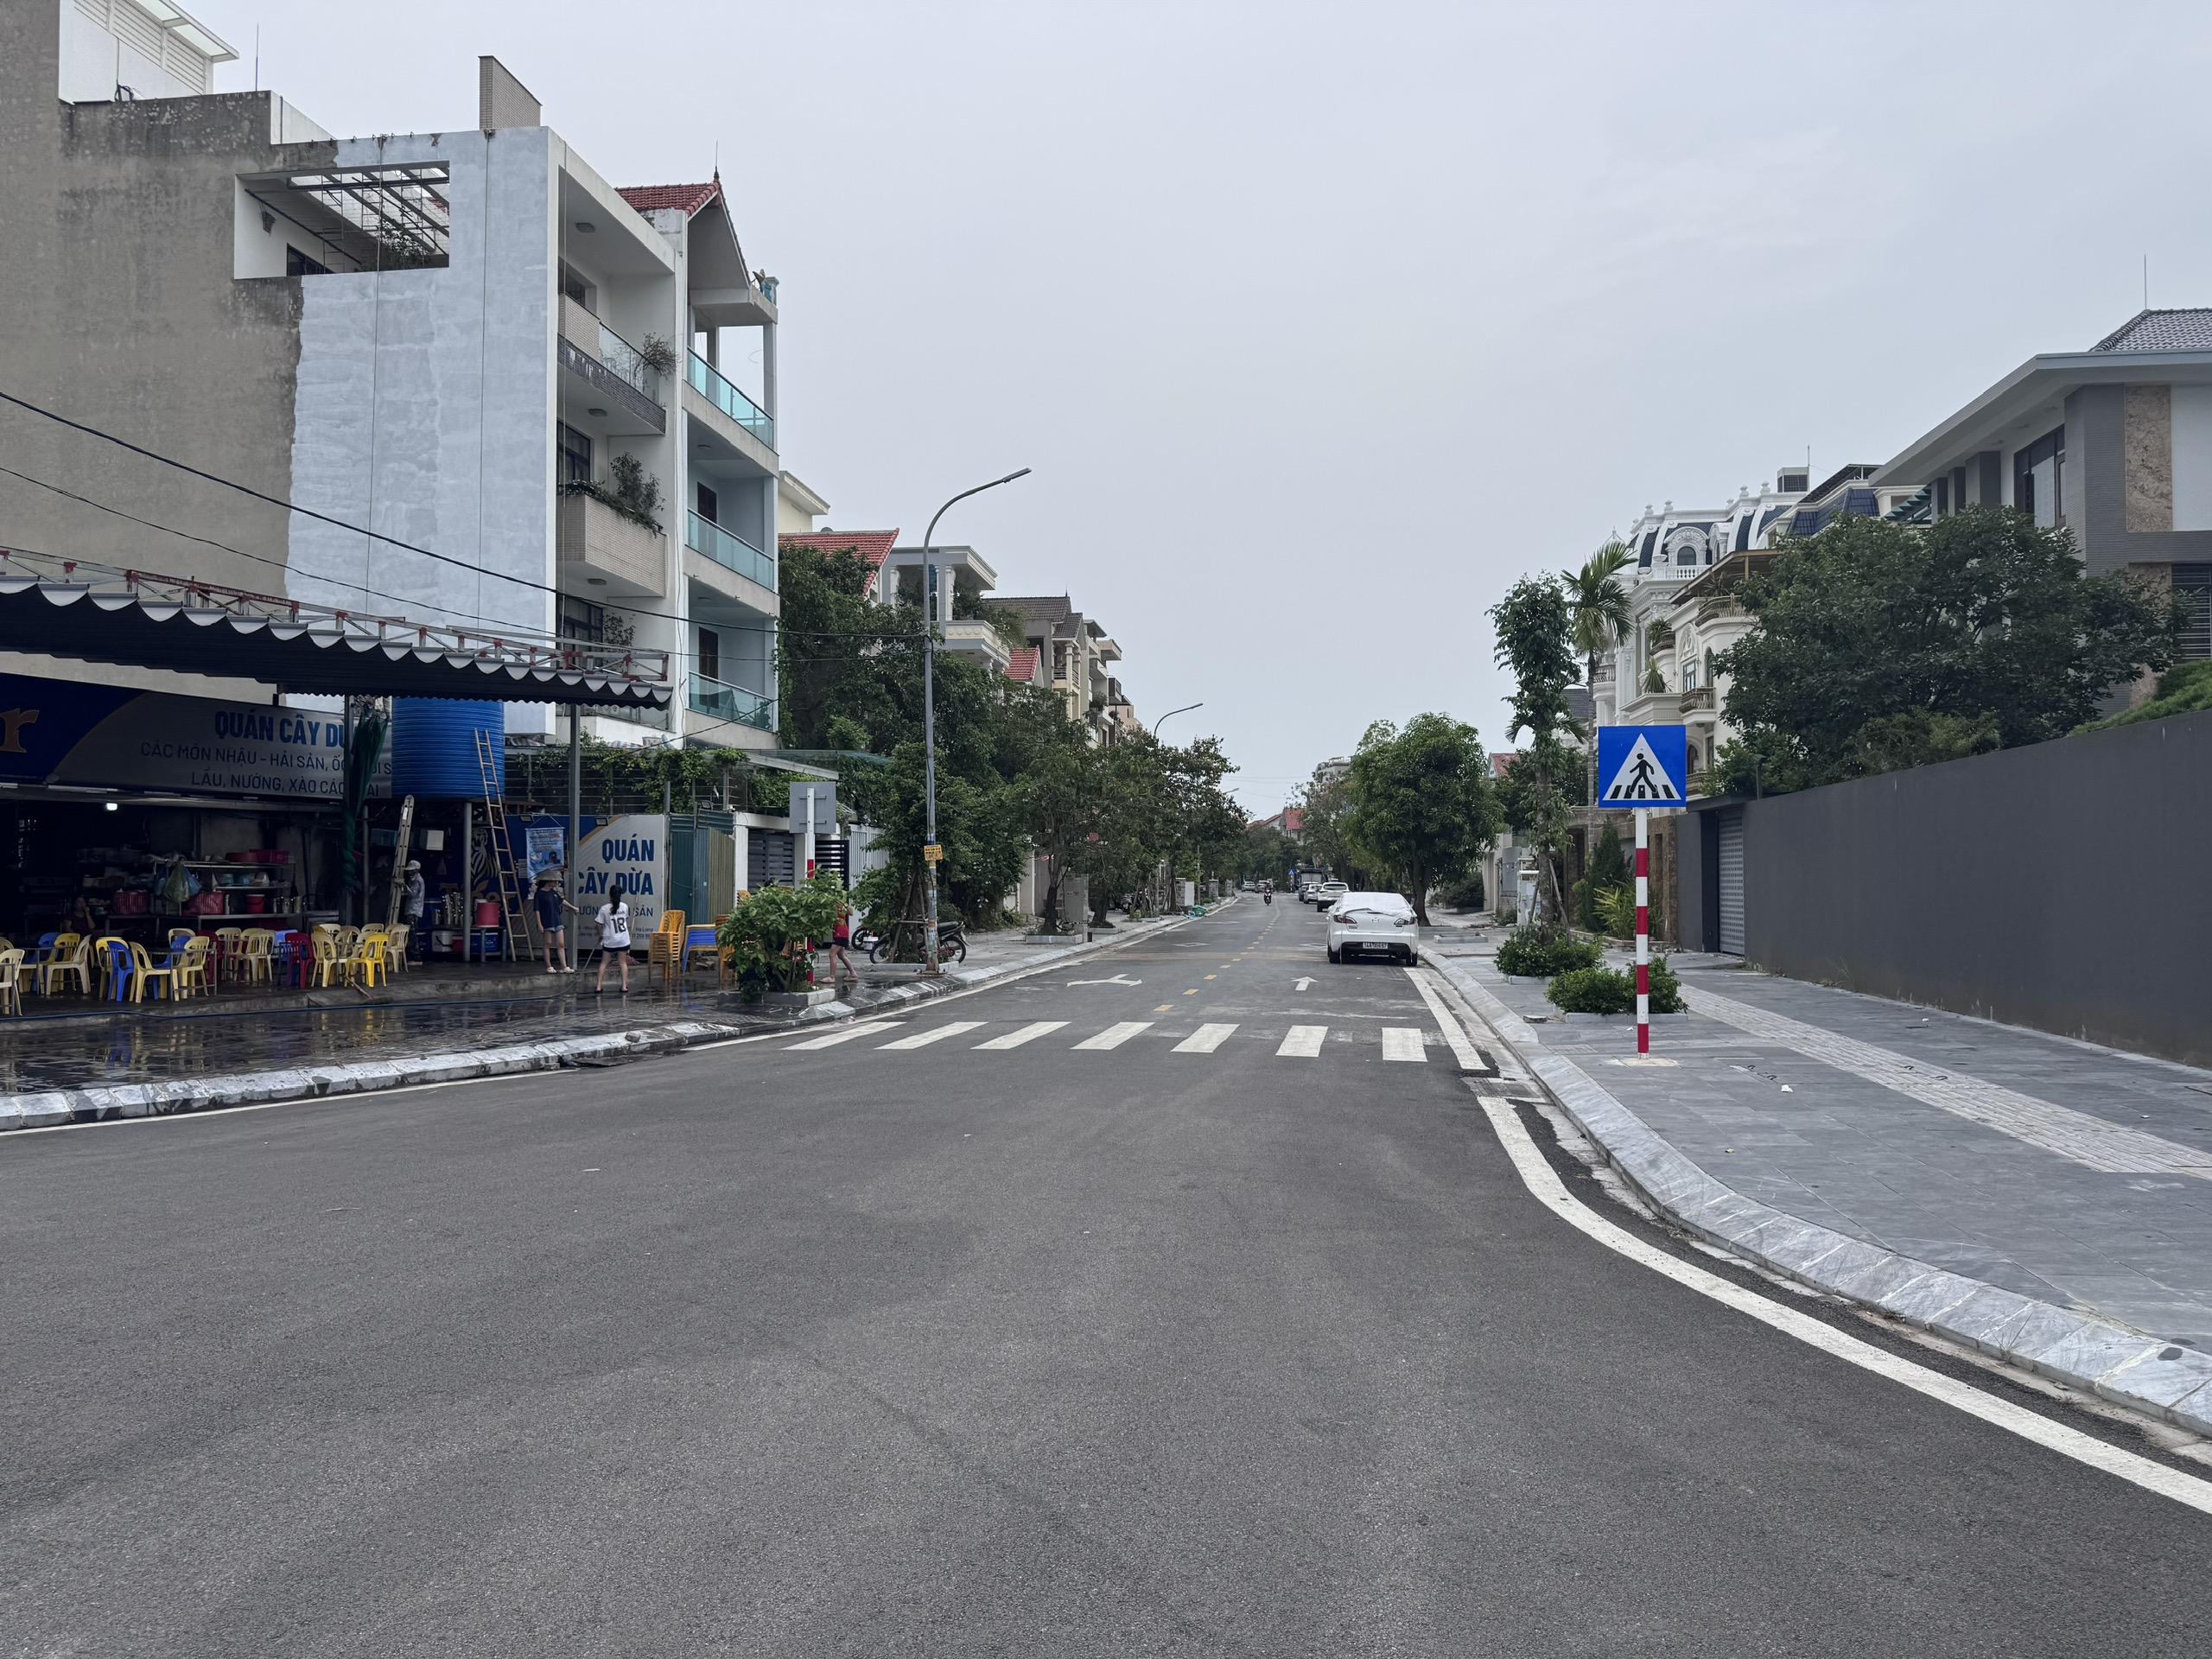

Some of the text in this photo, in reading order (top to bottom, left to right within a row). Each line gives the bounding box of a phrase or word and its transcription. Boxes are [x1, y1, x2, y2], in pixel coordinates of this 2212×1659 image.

[215, 709, 274, 741] QUÁN
[280, 714, 321, 746] CÂY
[178, 743, 211, 760] MÓN
[216, 747, 257, 766] NHẬU
[270, 750, 293, 767] HẢI
[297, 753, 328, 772] SẢN,
[192, 766, 226, 788] LẨU,
[231, 772, 284, 792] NƯỚNG,
[289, 776, 316, 793] XÀO
[601, 833, 655, 863] QUÁN
[615, 867, 654, 895] DỪA
[611, 917, 626, 934] 18
